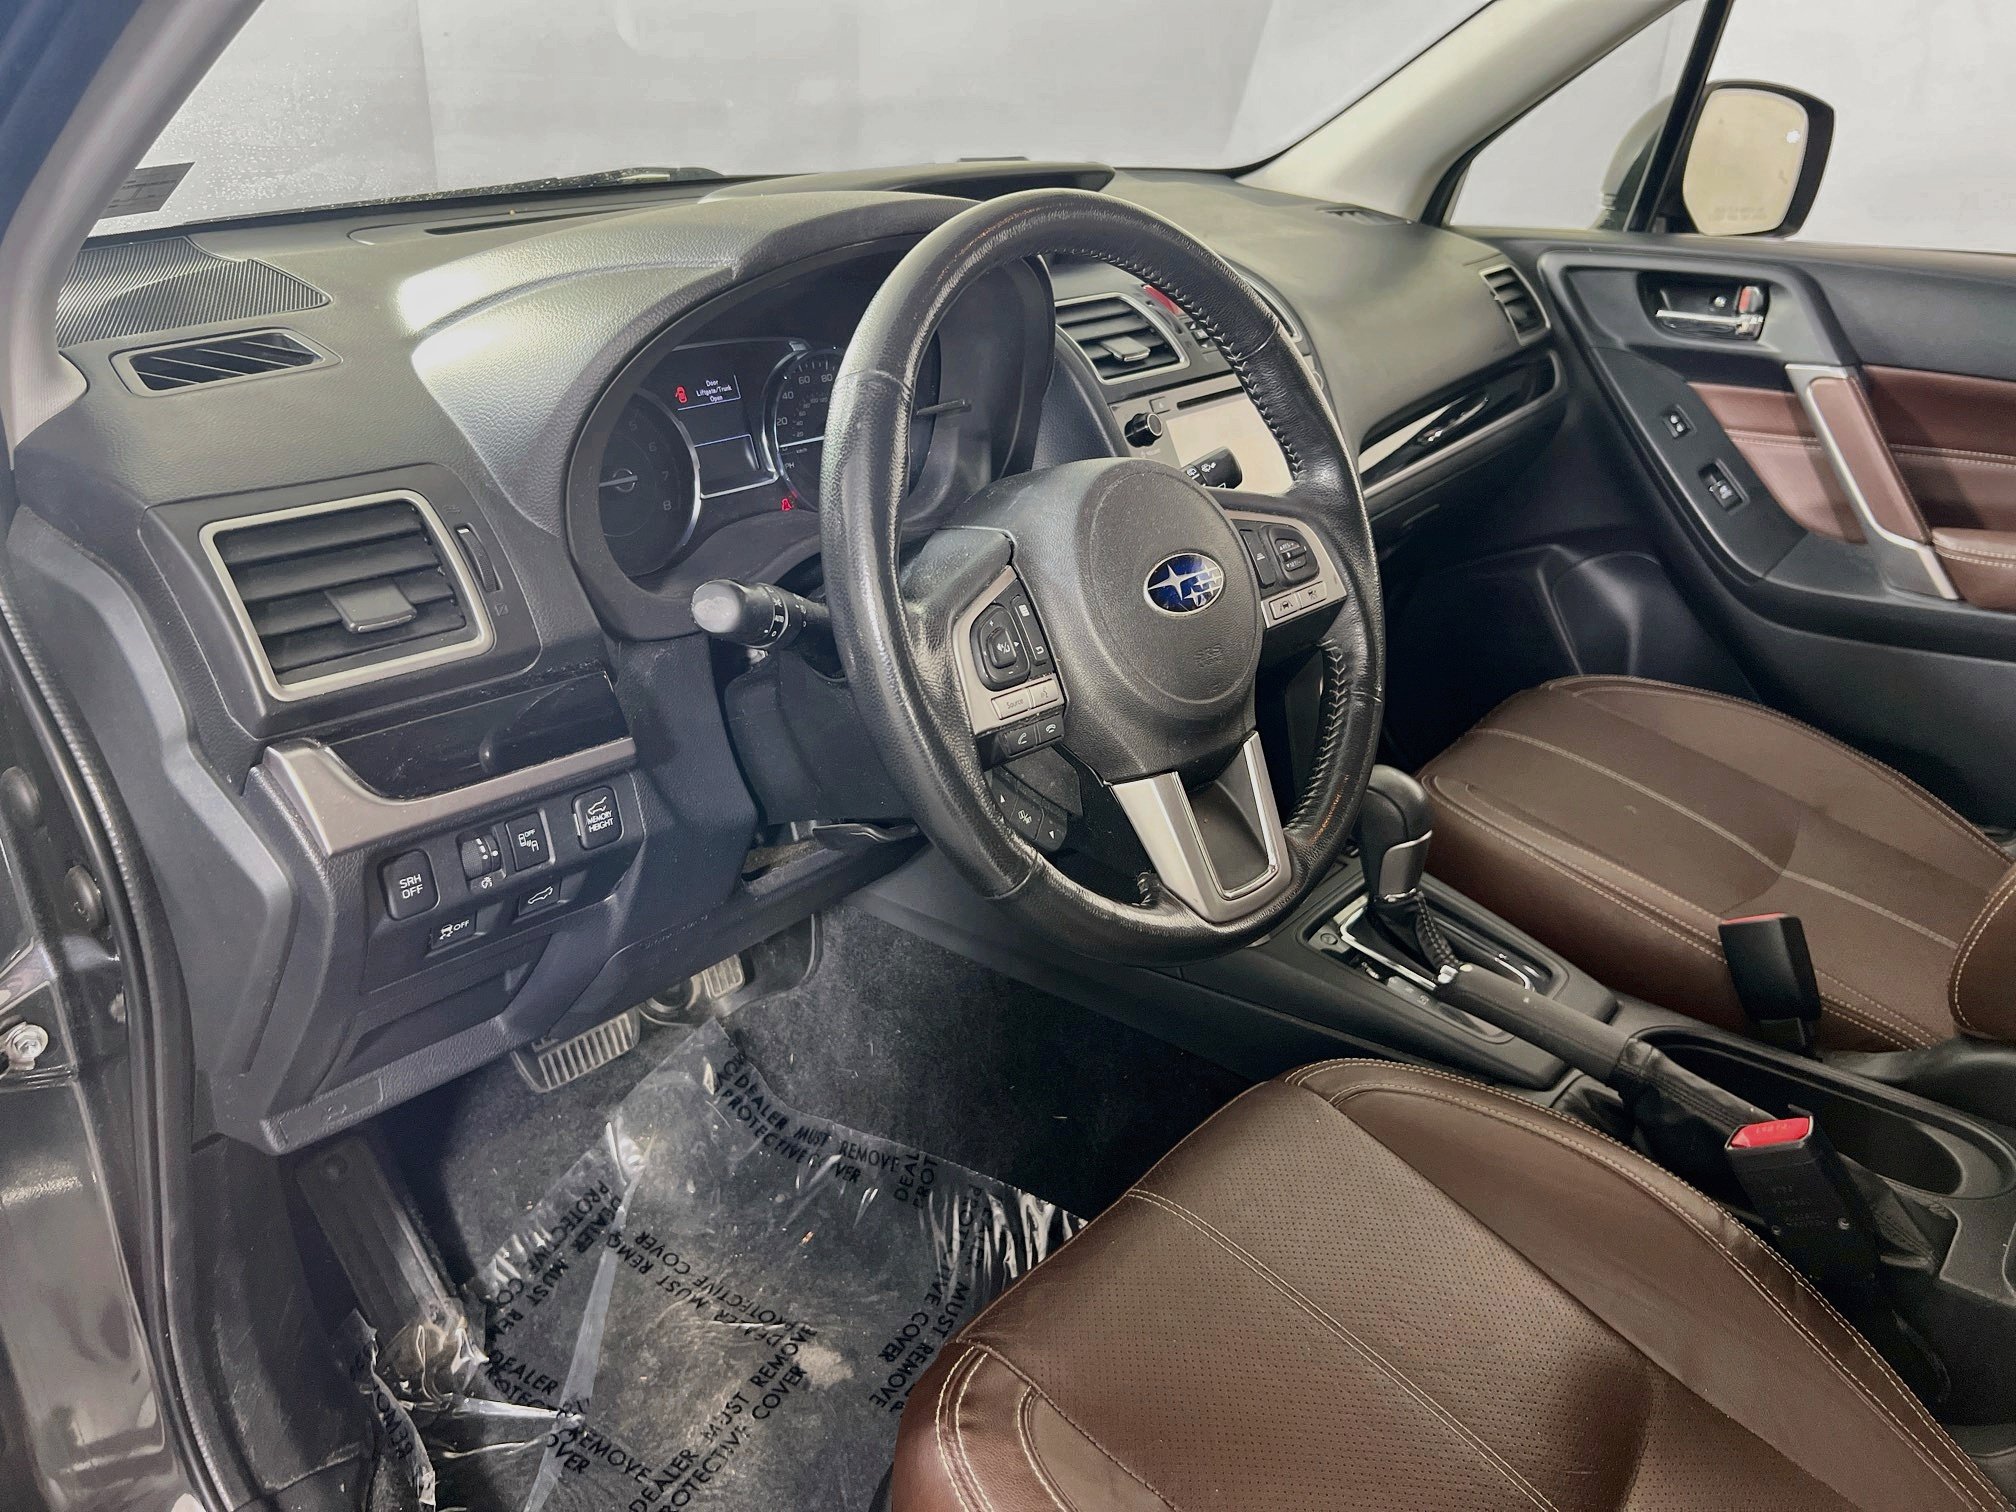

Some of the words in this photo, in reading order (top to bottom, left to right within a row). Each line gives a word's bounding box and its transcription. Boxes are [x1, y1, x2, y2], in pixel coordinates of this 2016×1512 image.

[705, 379, 719, 387] Door
[821, 373, 833, 383] 80
[782, 391, 795, 400] 40
[776, 416, 788, 426] 20
[661, 470, 670, 482] 7
[662, 499, 673, 512] 8
[1006, 697, 1024, 711] Source
[587, 810, 613, 826] MEMORY
[588, 817, 614, 832] HEIGHT
[524, 828, 536, 838] OFF
[399, 873, 422, 889] SRH
[402, 884, 423, 899] OFF
[453, 919, 470, 931] OFF
[734, 1073, 790, 1131] DEALER
[793, 1125, 831, 1148] MUST
[721, 1088, 808, 1164] PROTECTIVE
[635, 1230, 691, 1275] COVER
[655, 1274, 709, 1310] MUST
[933, 1279, 971, 1339] MUST
[877, 1310, 929, 1363] COVER
[869, 1341, 936, 1409] REMOVE
[699, 1391, 750, 1444] MUST
[750, 1323, 818, 1388] REMOVE
[751, 1365, 808, 1421] COVER
